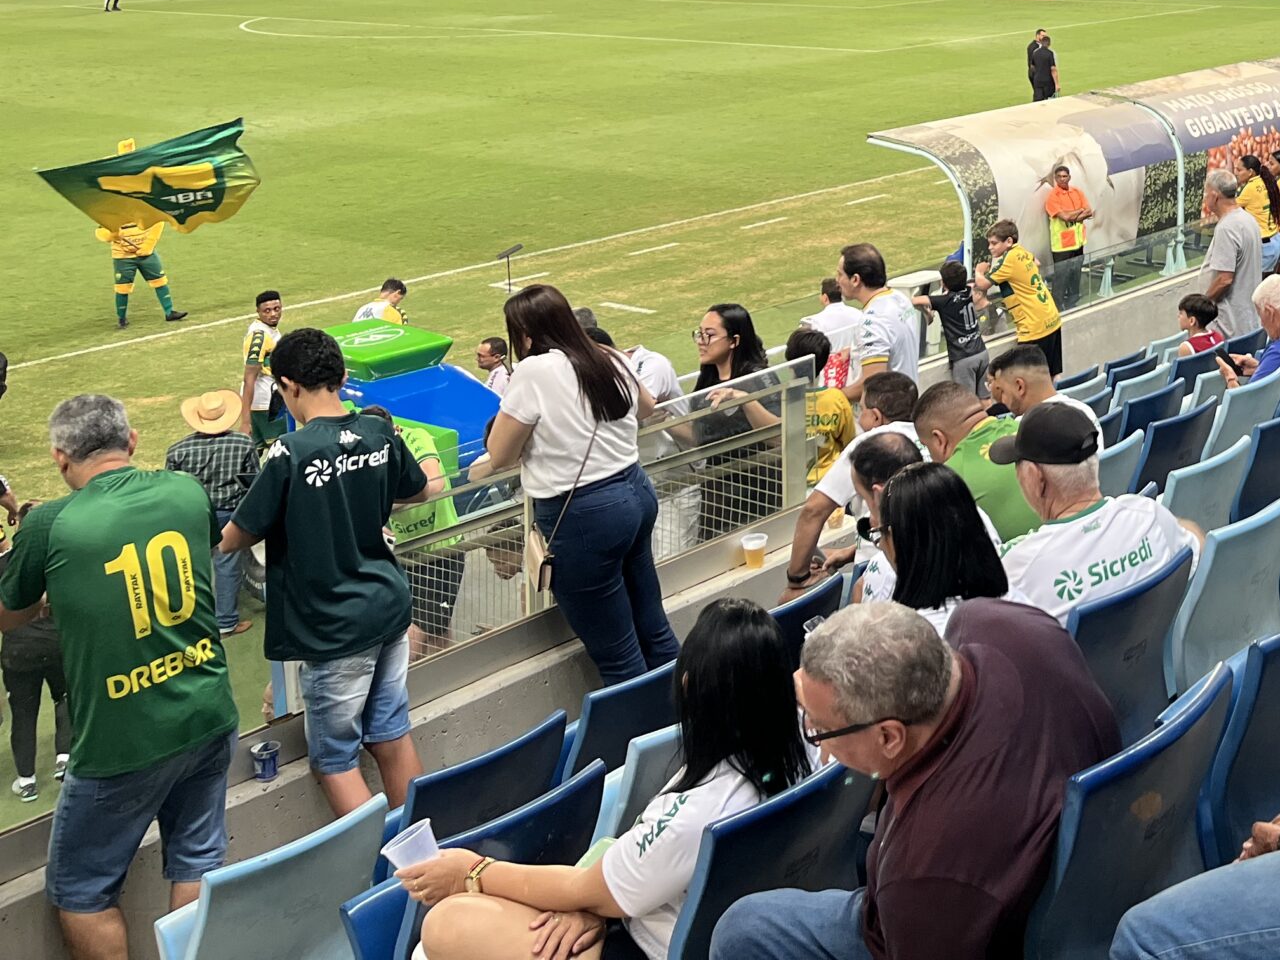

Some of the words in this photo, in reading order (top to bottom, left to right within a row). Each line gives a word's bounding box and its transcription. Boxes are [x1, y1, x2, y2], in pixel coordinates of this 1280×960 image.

[1162, 92, 1212, 112] MATO
[1184, 108, 1254, 138] GIGANTE
[1250, 102, 1274, 122] DO
[959, 302, 978, 331] 10
[335, 444, 391, 477] Sicredi
[180, 557, 191, 593] RAYTAK
[1088, 536, 1153, 587] Sicredi
[104, 530, 196, 640] 10
[130, 573, 143, 610] RAYTAK
[106, 638, 216, 700] DREBOR
